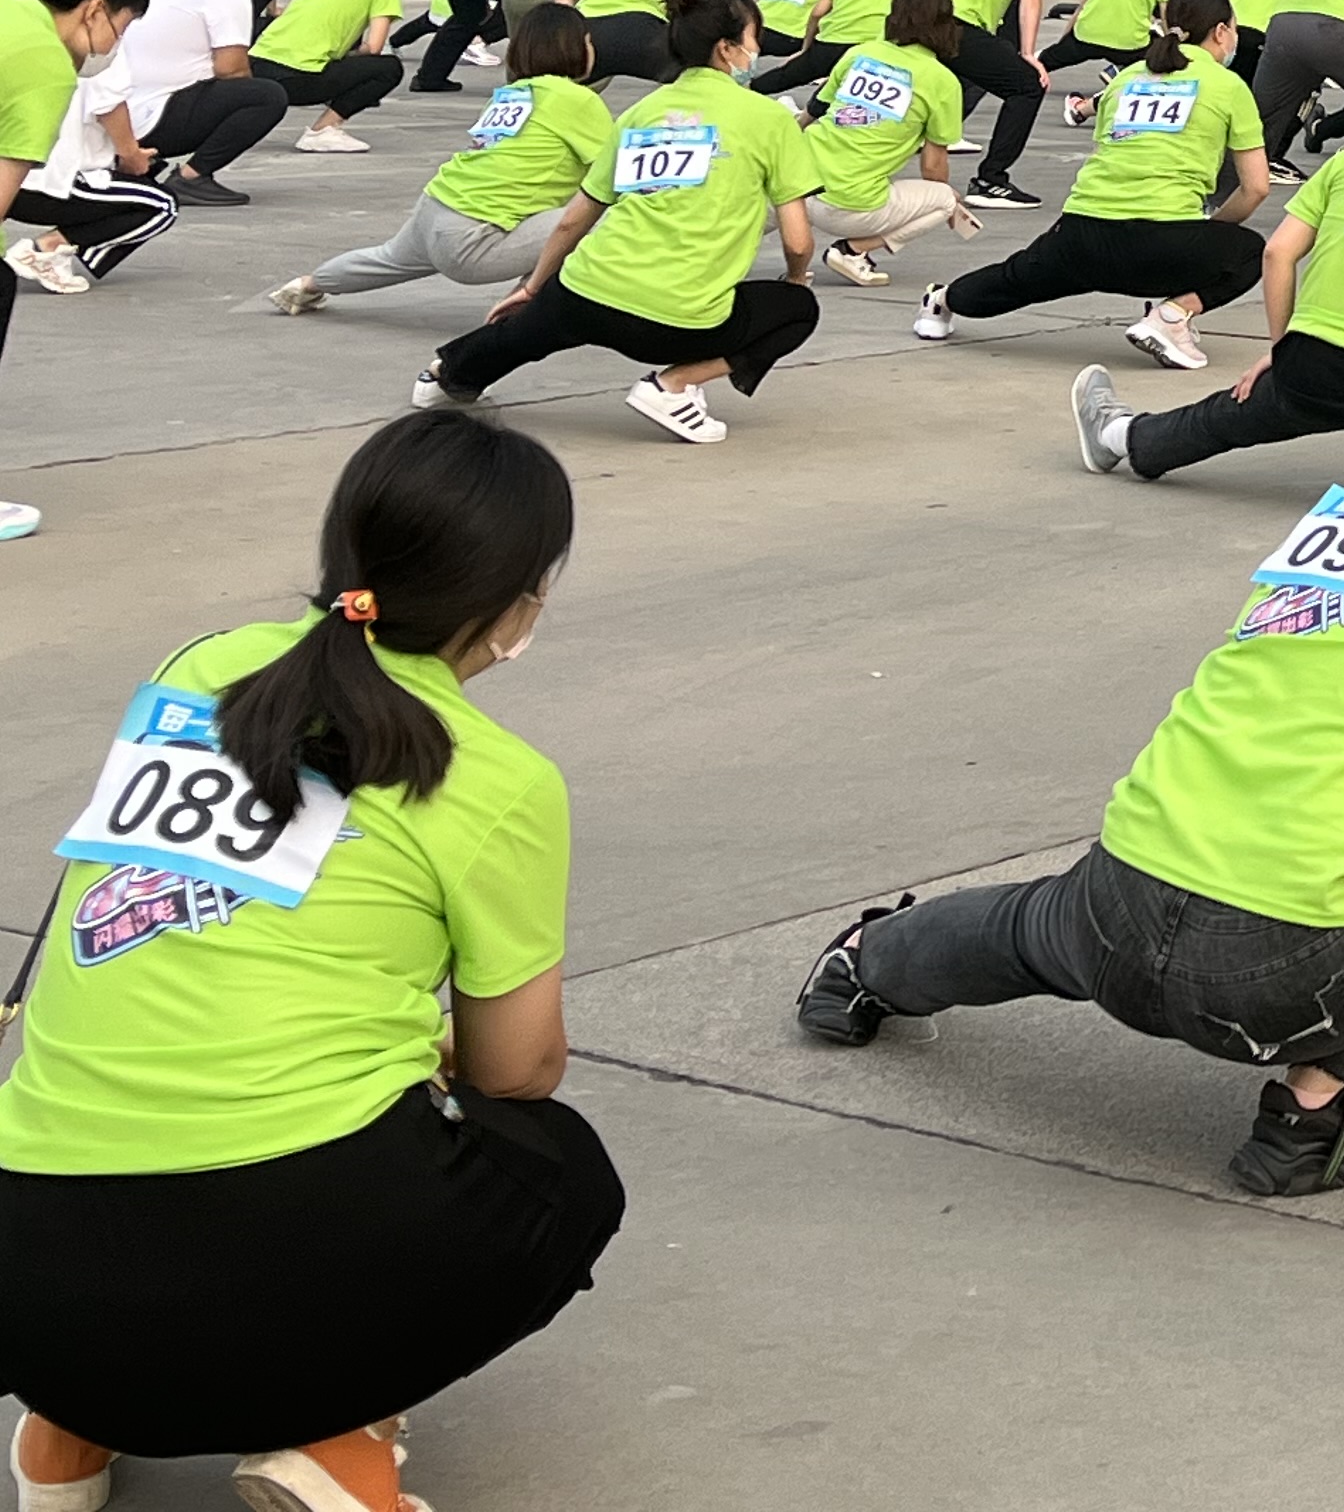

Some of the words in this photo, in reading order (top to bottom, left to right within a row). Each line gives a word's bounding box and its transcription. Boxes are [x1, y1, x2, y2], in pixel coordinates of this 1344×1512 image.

[849, 74, 902, 110] 092
[482, 105, 524, 129] 033
[1126, 98, 1181, 125] 114
[633, 149, 694, 181] 107
[107, 759, 295, 862] 089
